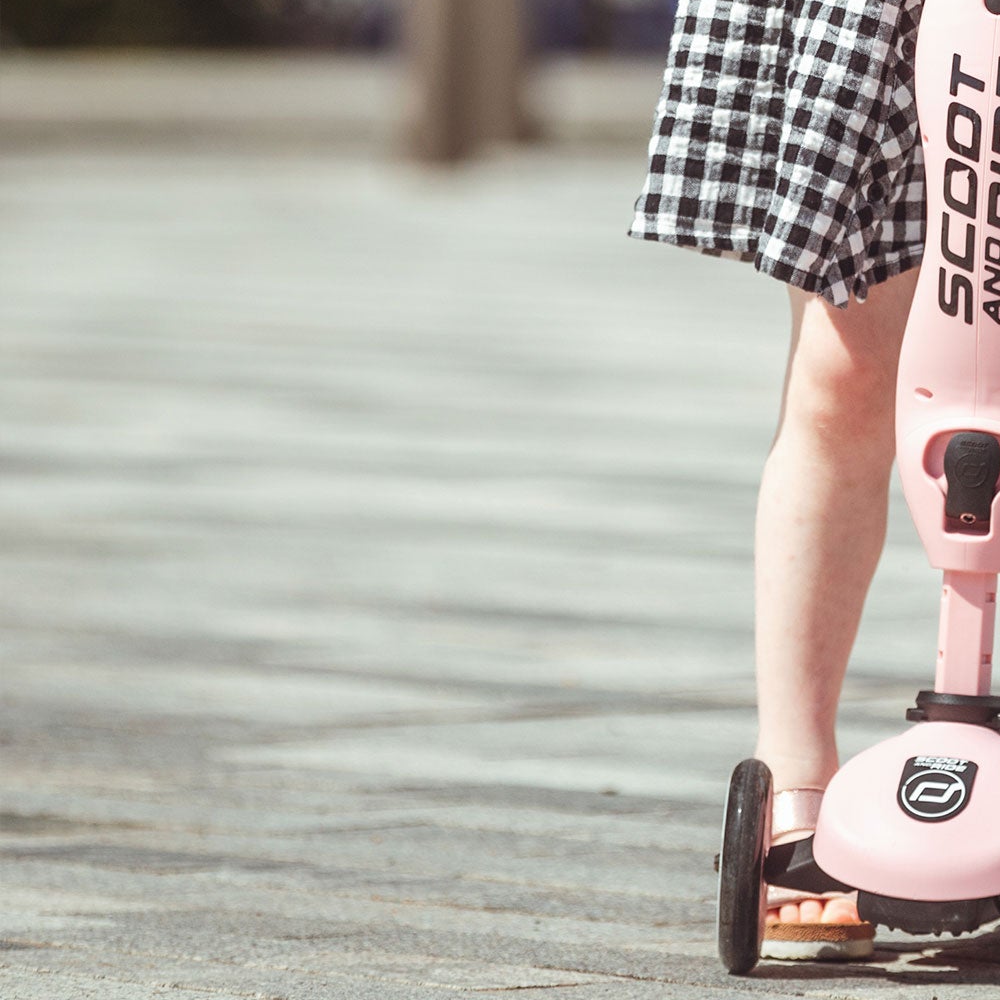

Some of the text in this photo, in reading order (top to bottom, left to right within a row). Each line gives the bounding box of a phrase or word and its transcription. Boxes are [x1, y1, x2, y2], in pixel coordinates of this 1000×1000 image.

[938, 53, 985, 325] SCOOT
[914, 756, 969, 766] SCOOT
[930, 763, 968, 772] RIDE
